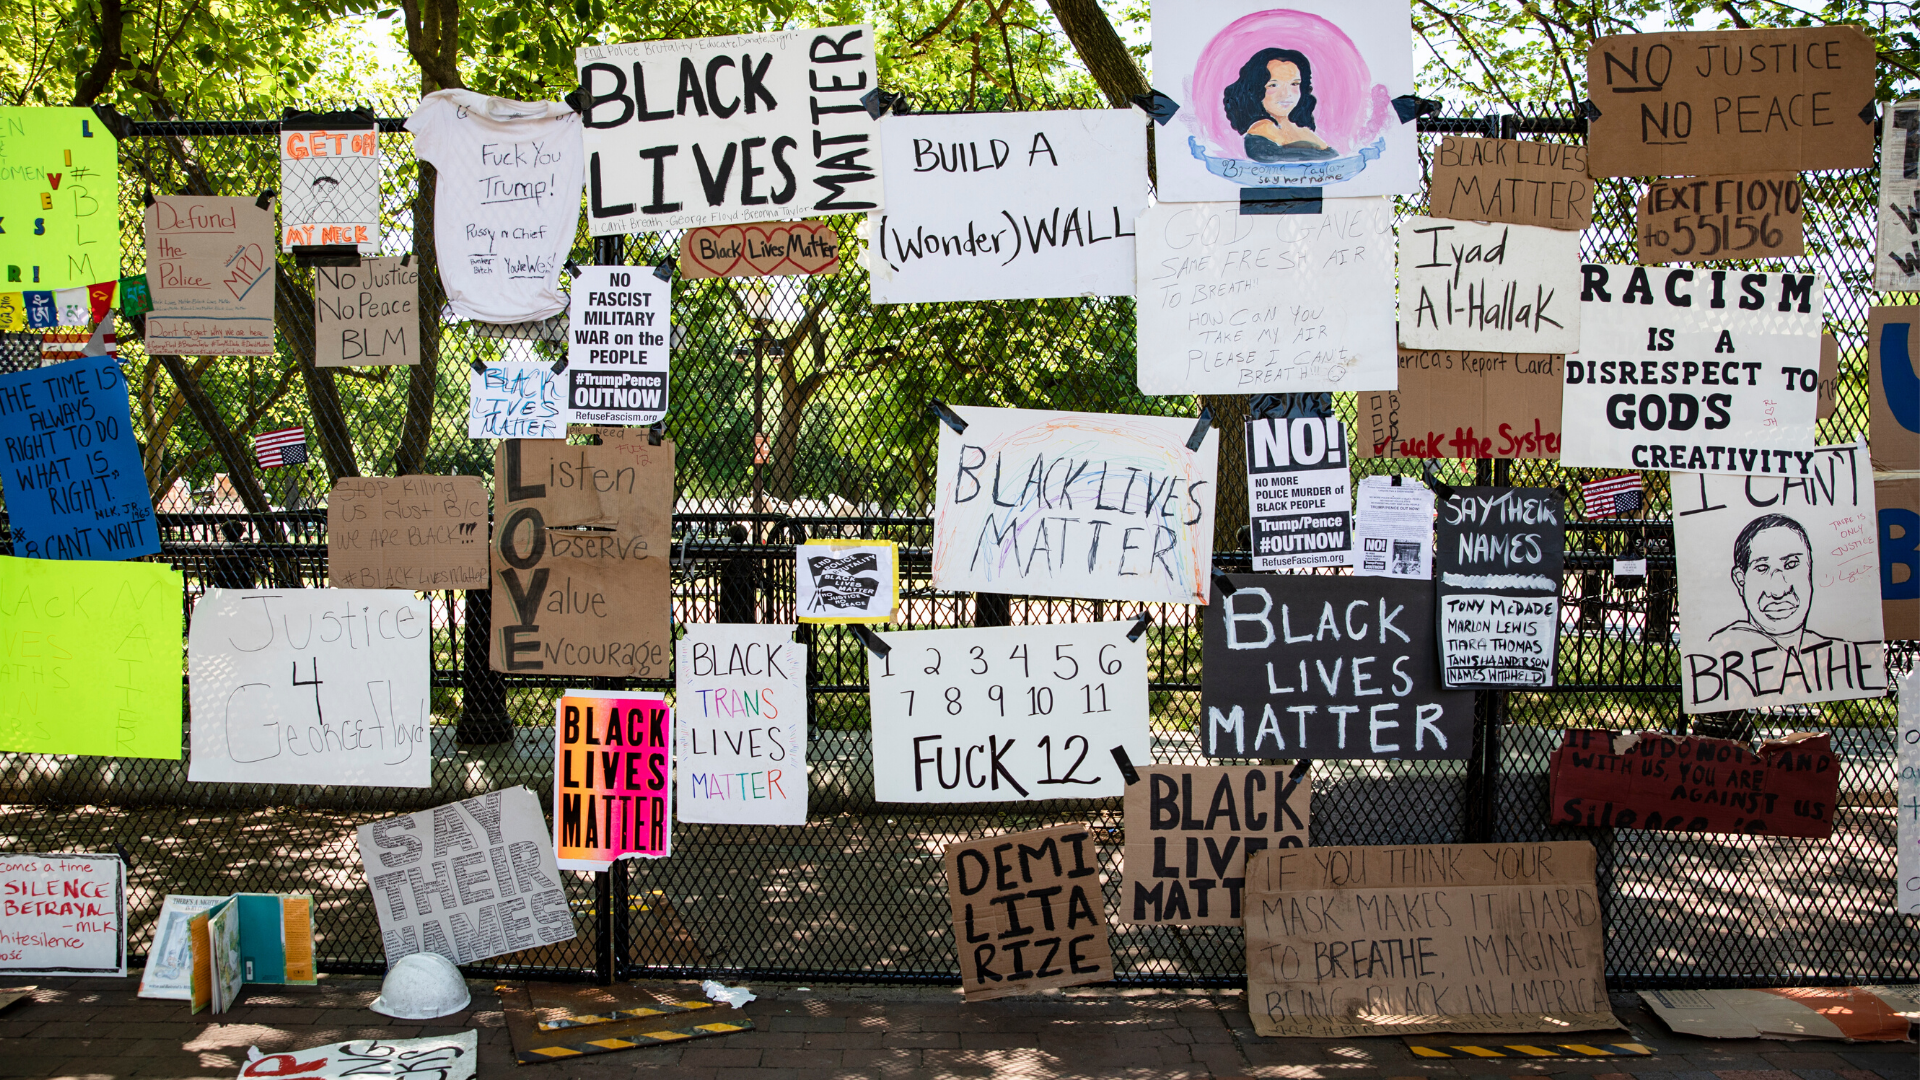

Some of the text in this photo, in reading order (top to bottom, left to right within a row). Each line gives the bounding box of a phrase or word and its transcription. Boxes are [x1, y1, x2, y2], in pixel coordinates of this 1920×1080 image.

[1605, 41, 1842, 90] NO JUSTICE
[581, 52, 778, 129] BLACK
[809, 29, 878, 211] MATTER
[1641, 92, 1835, 142] NO PEACE
[286, 131, 376, 160] GET OFF
[482, 141, 561, 168] Fuck You
[913, 131, 1058, 173] BUILD A
[1439, 137, 1587, 173] BLACK LIVES
[590, 135, 798, 218] LIVES
[1449, 176, 1586, 222] MATTER
[156, 201, 236, 230] Defund
[630, 216, 663, 229] Breath
[669, 213, 707, 226] George
[710, 211, 739, 223] Floyd
[781, 205, 810, 218] Taylor
[158, 237, 187, 258] the
[286, 225, 369, 245] MY NECK
[700, 233, 838, 260] Black Lives Matter
[1645, 213, 1783, 256] to 55156
[159, 262, 211, 289] Police
[317, 258, 418, 291] No Justice
[473, 266, 493, 274] Bitch
[1152, 246, 1366, 280] SAME FRESH AIR
[609, 273, 631, 287] NO
[1580, 265, 1814, 313] RACISM
[318, 292, 411, 322] No Peace
[589, 292, 652, 307] FASCIST
[584, 311, 655, 327] MILITARY
[1199, 325, 1328, 344] TAKE MY AIR
[342, 327, 406, 360] BLM
[575, 330, 664, 346] WAR on the
[1647, 327, 1735, 353] IS A
[590, 350, 648, 365] PEOPLE
[0, 366, 117, 415] THE TIME IS
[576, 372, 661, 388] #TrumpPence
[1567, 361, 1818, 392] DISRESPECT TO
[472, 397, 559, 418] LIVES
[574, 387, 662, 409] OUTNOW
[1606, 393, 1732, 431] GOD'S
[30, 397, 95, 432] ALWAYS
[480, 413, 558, 437] MATTER
[575, 411, 658, 423] RefuseFascism.org
[5, 416, 118, 463] RIGHT TO DO
[1253, 417, 1341, 468] NO!
[16, 451, 109, 491] WHAT IS
[1632, 445, 1814, 474] CREATIVITY
[955, 444, 1209, 526] BLACK LIVES
[1255, 476, 1299, 487] NO MORE
[1256, 485, 1344, 499] POLICE MURDER of
[131, 507, 150, 520] 1965
[1256, 499, 1326, 512] BLACK PEOPLE
[1259, 516, 1343, 532] Trump/Pence
[970, 513, 1178, 581] MATTER
[1259, 532, 1344, 553] #OUTNOW
[1365, 539, 1386, 552] NO!
[1458, 532, 1542, 568] NAMES
[813, 558, 831, 569] END
[824, 555, 857, 570] POLICE
[1262, 555, 1344, 567] RefuseFascism.org
[824, 574, 856, 582] BLACK
[839, 586, 874, 594] MATTER
[1447, 600, 1484, 614] TONY
[1448, 619, 1537, 636] MARLON LEWIS
[693, 642, 788, 680] BLACK
[881, 644, 1122, 680] 1 2 3 4 5 6
[1490, 639, 1542, 654] THOMAS
[1266, 656, 1414, 697] LIVES
[1684, 640, 1888, 706] BREATHE
[695, 688, 778, 720] TRANS
[900, 683, 1111, 717] 7 8 9 10 11
[564, 706, 666, 747] BLACK
[1208, 703, 1448, 755] MATTER
[692, 726, 785, 761] LIVES
[564, 749, 665, 791] LIVES
[913, 735, 1101, 798] FUCK 12
[1572, 752, 1632, 775] WITH
[1679, 761, 1715, 787] YOU
[1726, 770, 1764, 792] ARE
[692, 769, 787, 801] MATTER
[1149, 770, 1304, 832] BLACK
[372, 791, 504, 869] SAY
[562, 793, 664, 851] MATTER
[43, 863, 55, 872] a
[59, 860, 93, 873] time
[957, 833, 1095, 895] DEMI
[1266, 846, 1554, 891] IF YOU THINK YOUR
[4, 878, 110, 899] SILENCE
[373, 840, 557, 921] THEIR
[4, 899, 115, 919] BETRAYAL
[966, 886, 1098, 943] LITA
[974, 934, 1100, 984] RIZE
